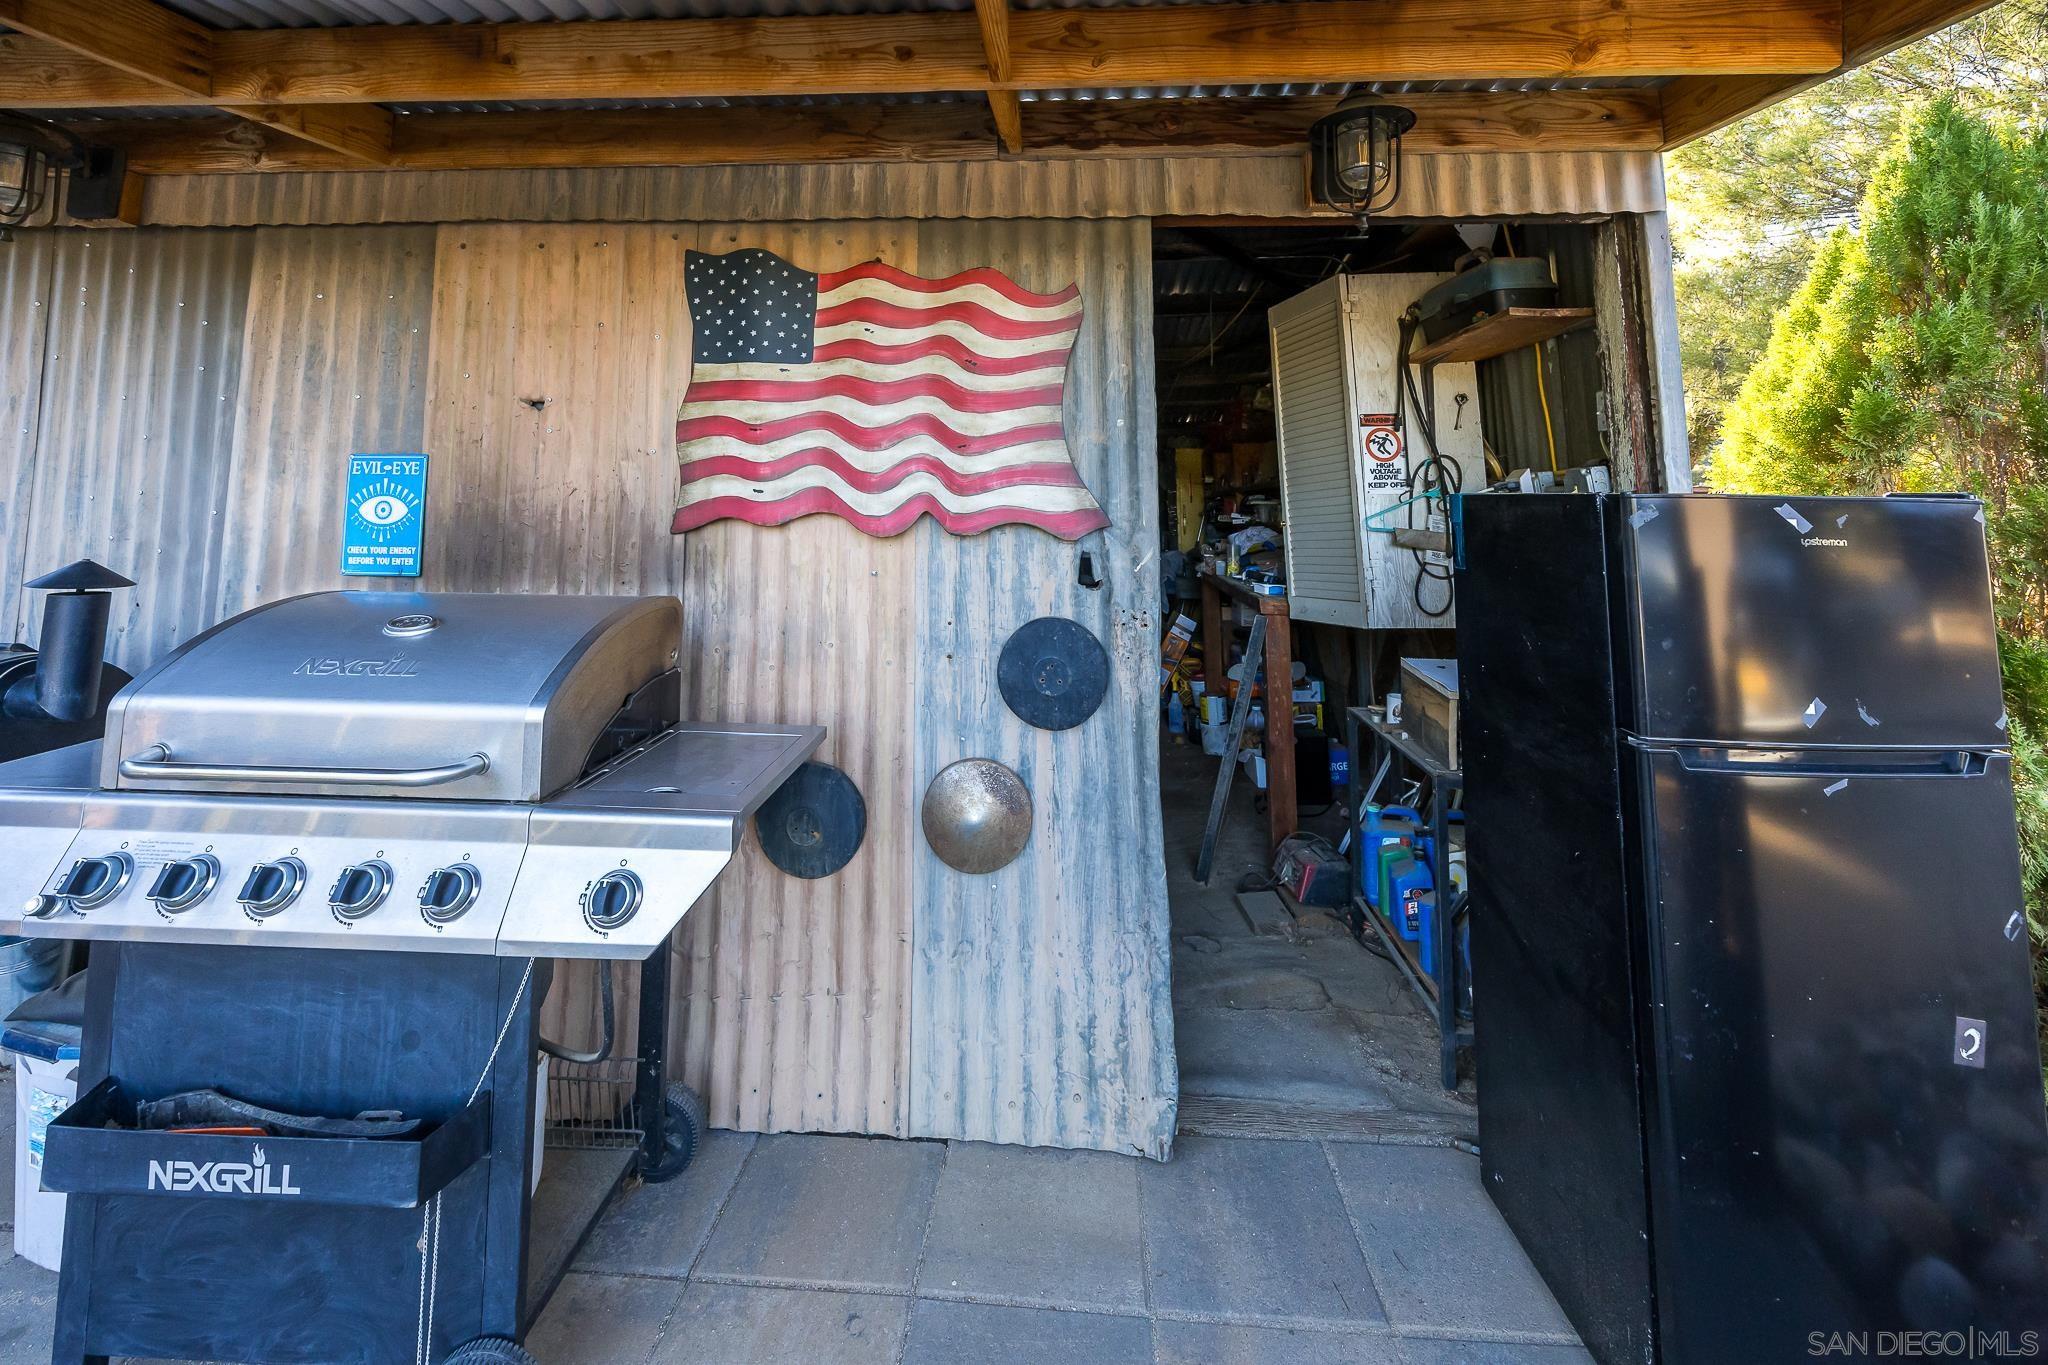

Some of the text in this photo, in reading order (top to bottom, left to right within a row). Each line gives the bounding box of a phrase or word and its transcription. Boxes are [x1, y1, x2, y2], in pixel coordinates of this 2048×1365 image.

[1801, 537, 1848, 547] upstreman
[347, 546, 416, 555] CHECK YOUR ENERGY
[348, 556, 414, 566] BEFORE YOU ENTER
[1330, 761, 1348, 770] RGE
[147, 1144, 301, 1195] NEXGRILL
